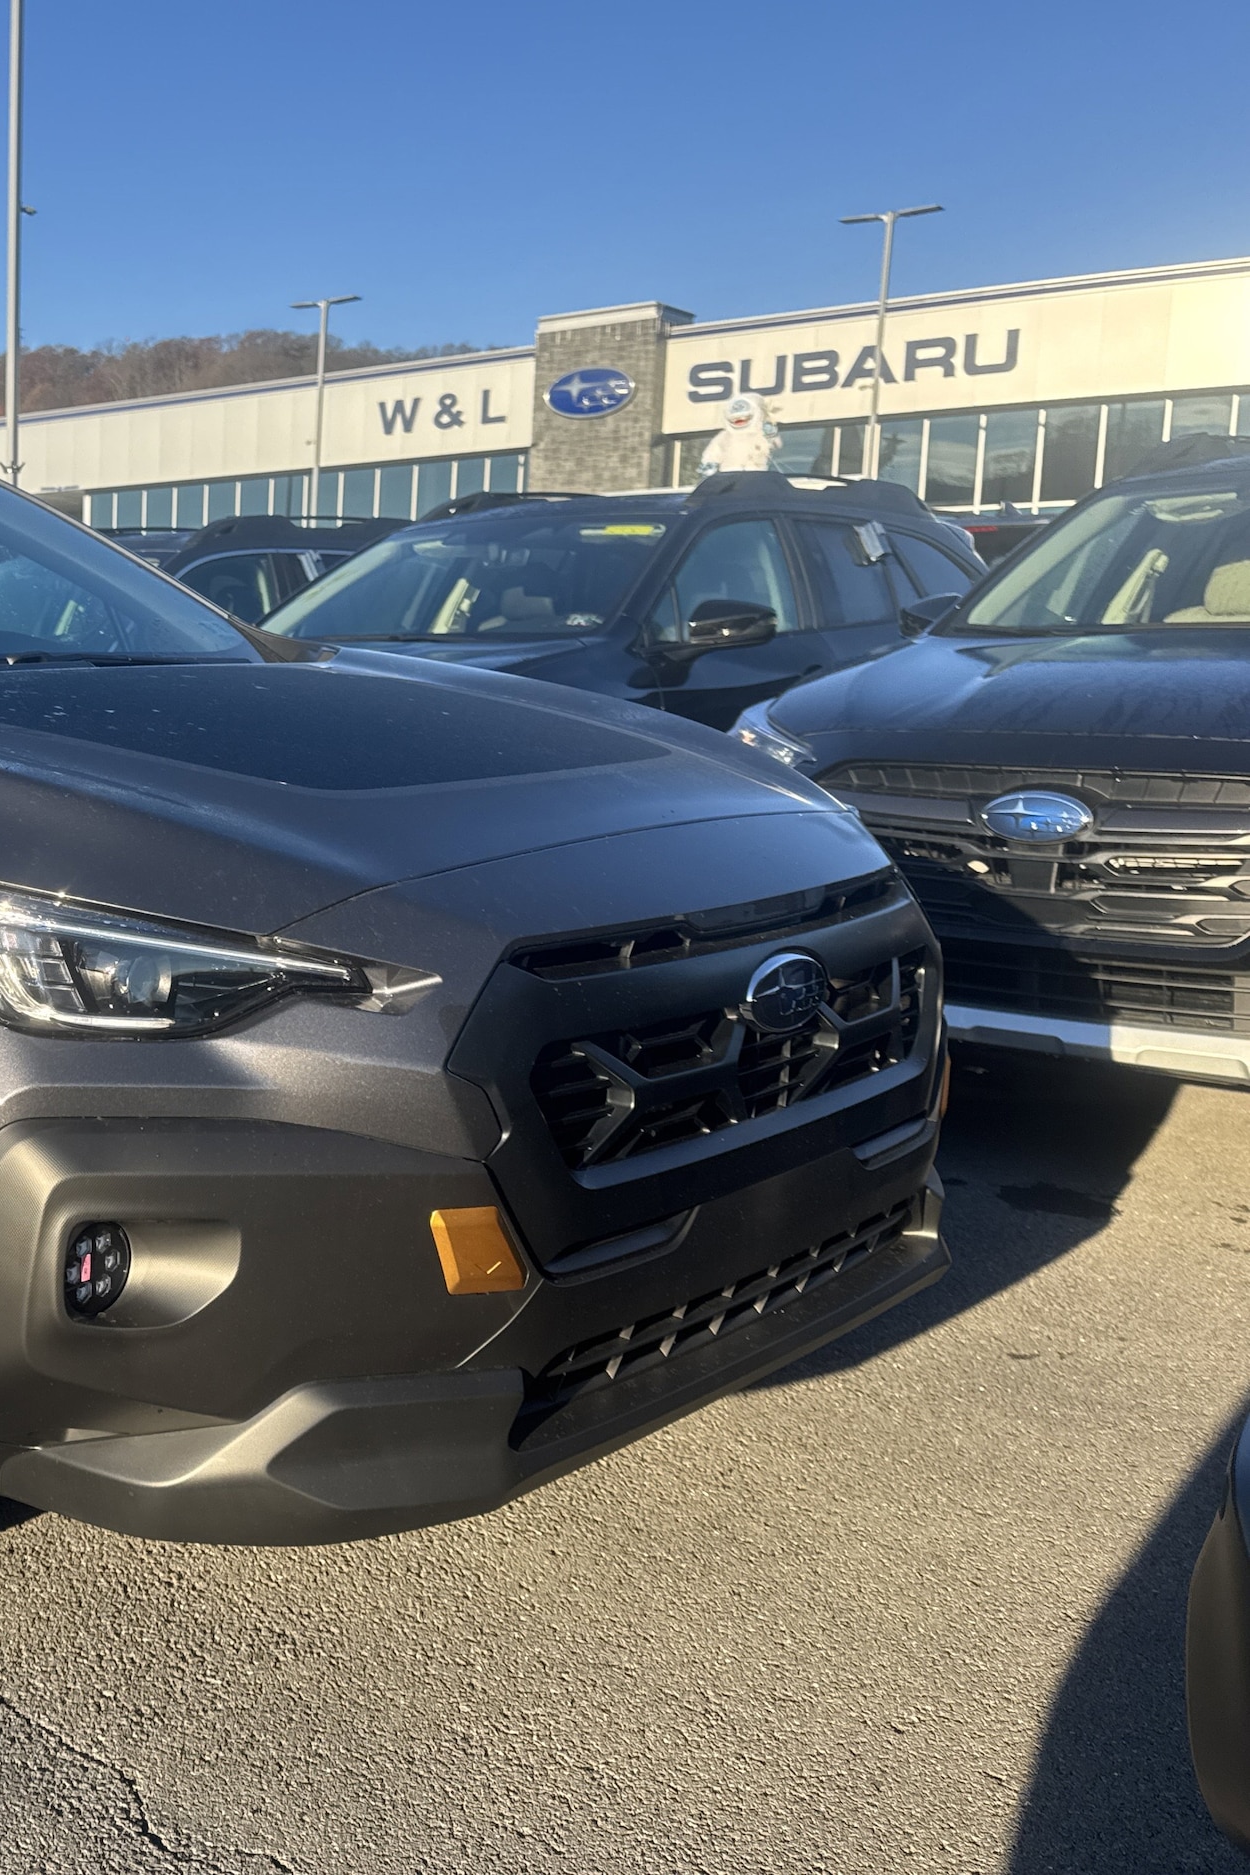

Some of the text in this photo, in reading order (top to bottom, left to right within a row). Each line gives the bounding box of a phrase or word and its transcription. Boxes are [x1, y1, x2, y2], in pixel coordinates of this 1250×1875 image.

[688, 329, 1020, 403] SUBARU
[378, 389, 507, 435] W & L
